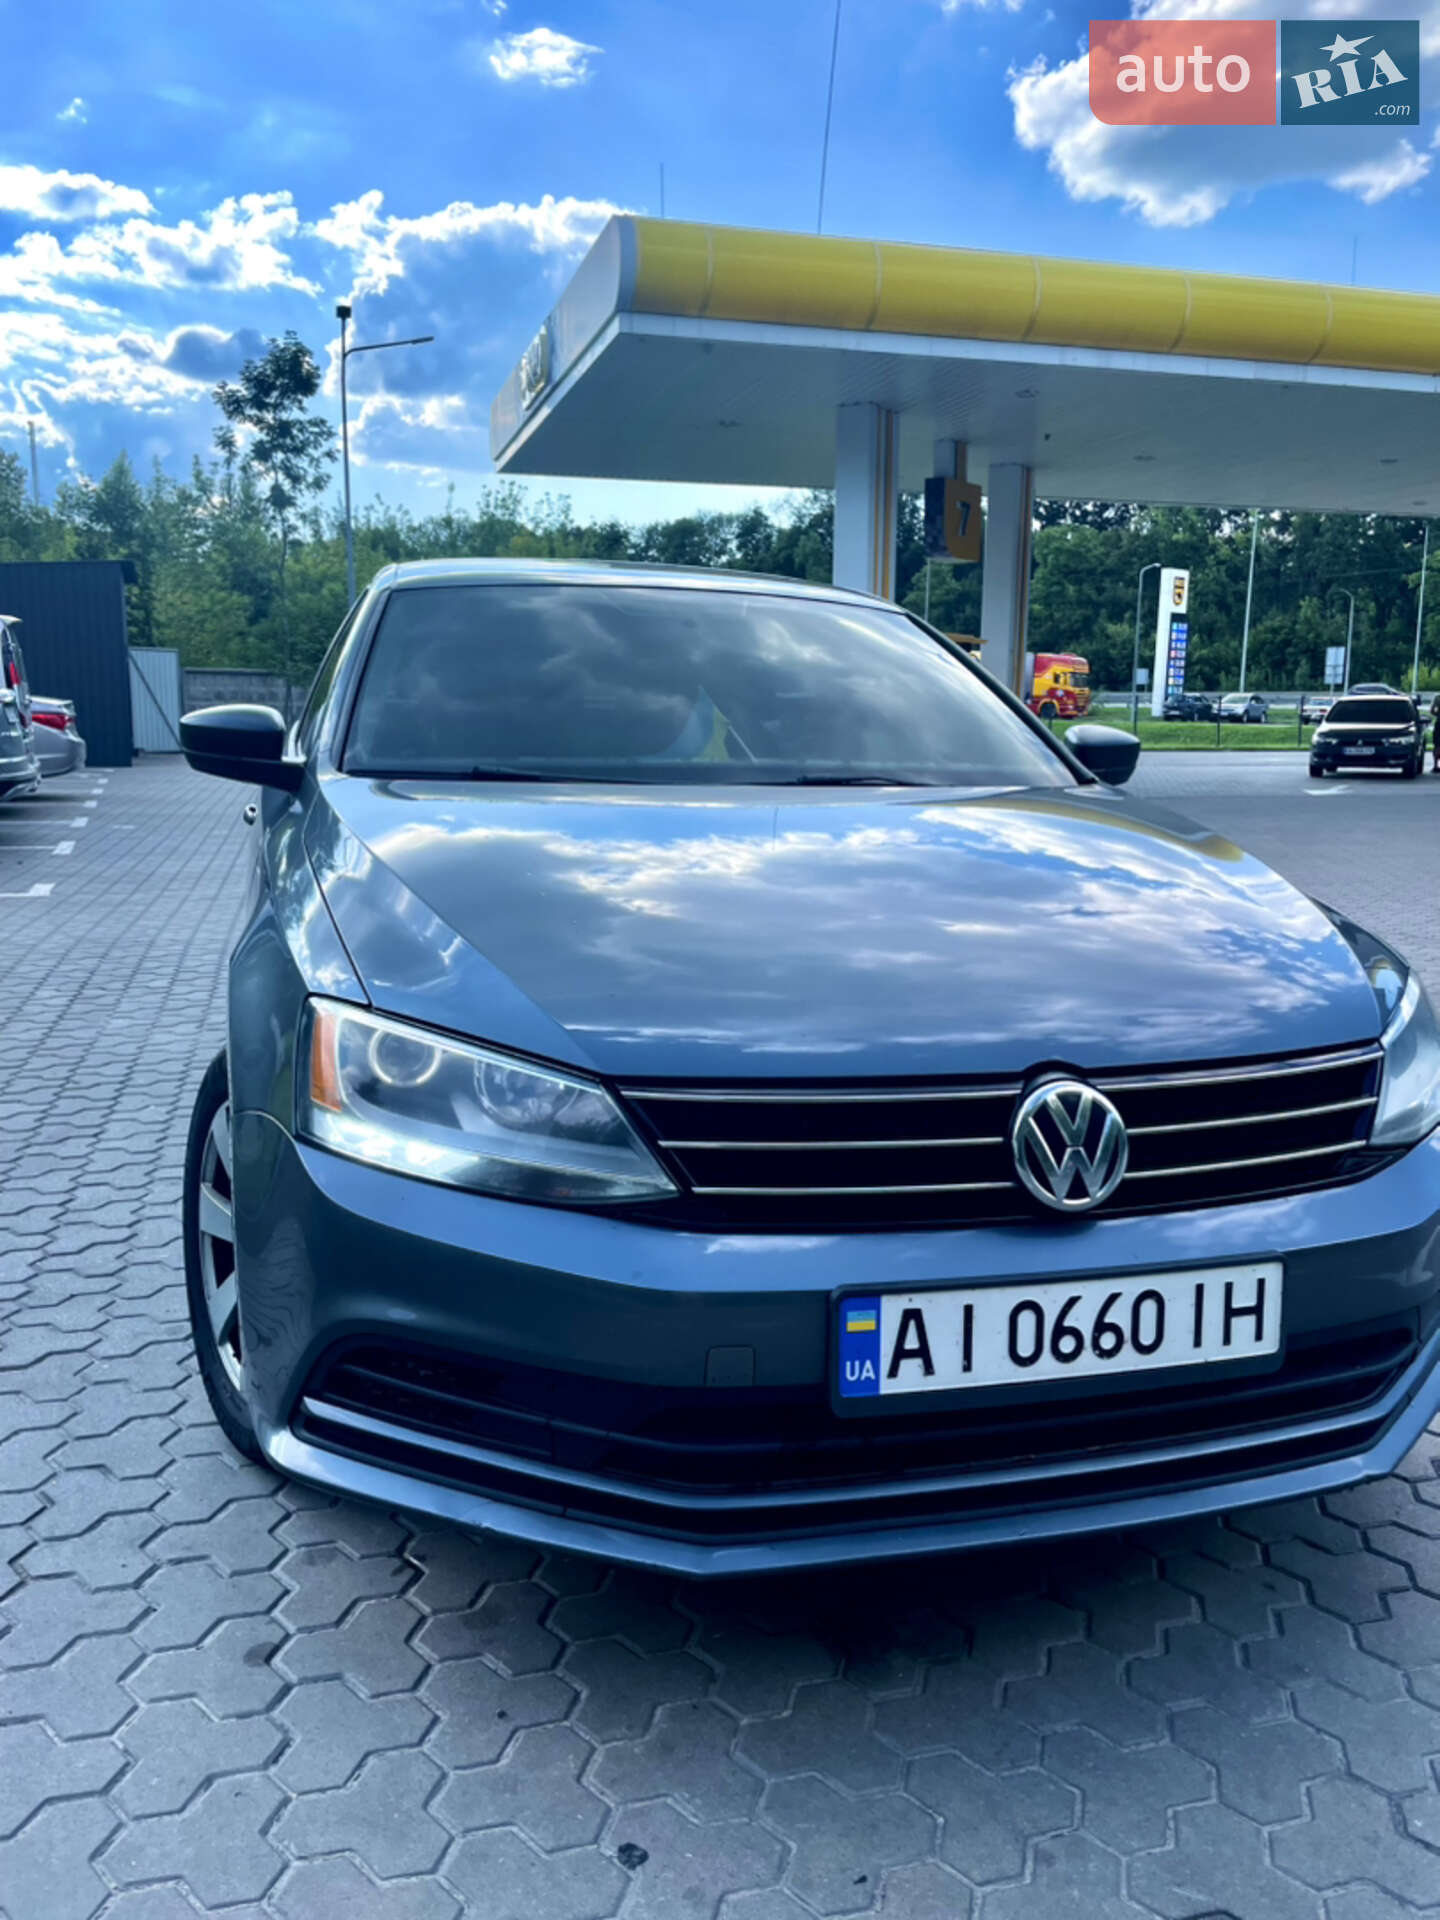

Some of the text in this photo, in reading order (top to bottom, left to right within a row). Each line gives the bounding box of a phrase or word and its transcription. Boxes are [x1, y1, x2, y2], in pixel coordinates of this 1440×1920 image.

[955, 501, 971, 537] 7
[1019, 1086, 1123, 1206] VW
[1008, 1289, 1165, 1368] 0660
[1193, 1278, 1266, 1348] IH
[845, 1359, 876, 1381] UA
